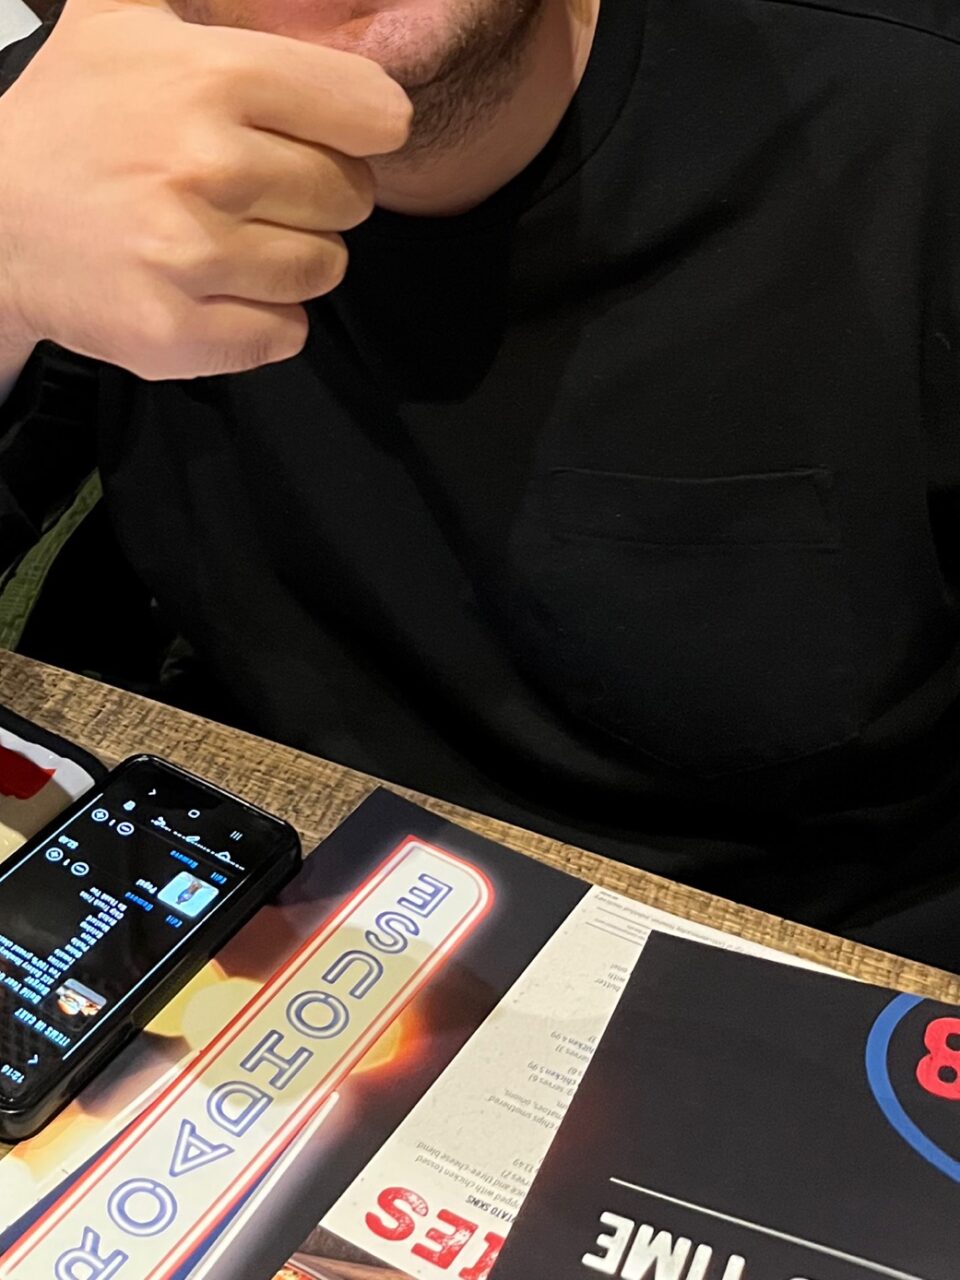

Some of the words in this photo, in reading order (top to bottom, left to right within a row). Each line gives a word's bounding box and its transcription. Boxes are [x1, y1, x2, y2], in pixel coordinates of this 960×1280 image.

[54, 872, 455, 1280] ROADHOUSE
[543, 1068, 576, 1087] chicken
[486, 1094, 532, 1119] smothered
[531, 1114, 555, 1130] chips
[416, 1140, 440, 1157] blend
[414, 1154, 443, 1172] tossed
[440, 1152, 494, 1183] three-cheese
[442, 1168, 475, 1188] chicken
[492, 1178, 510, 1190] and
[474, 1183, 494, 1196] with
[464, 1194, 491, 1211] SKINS
